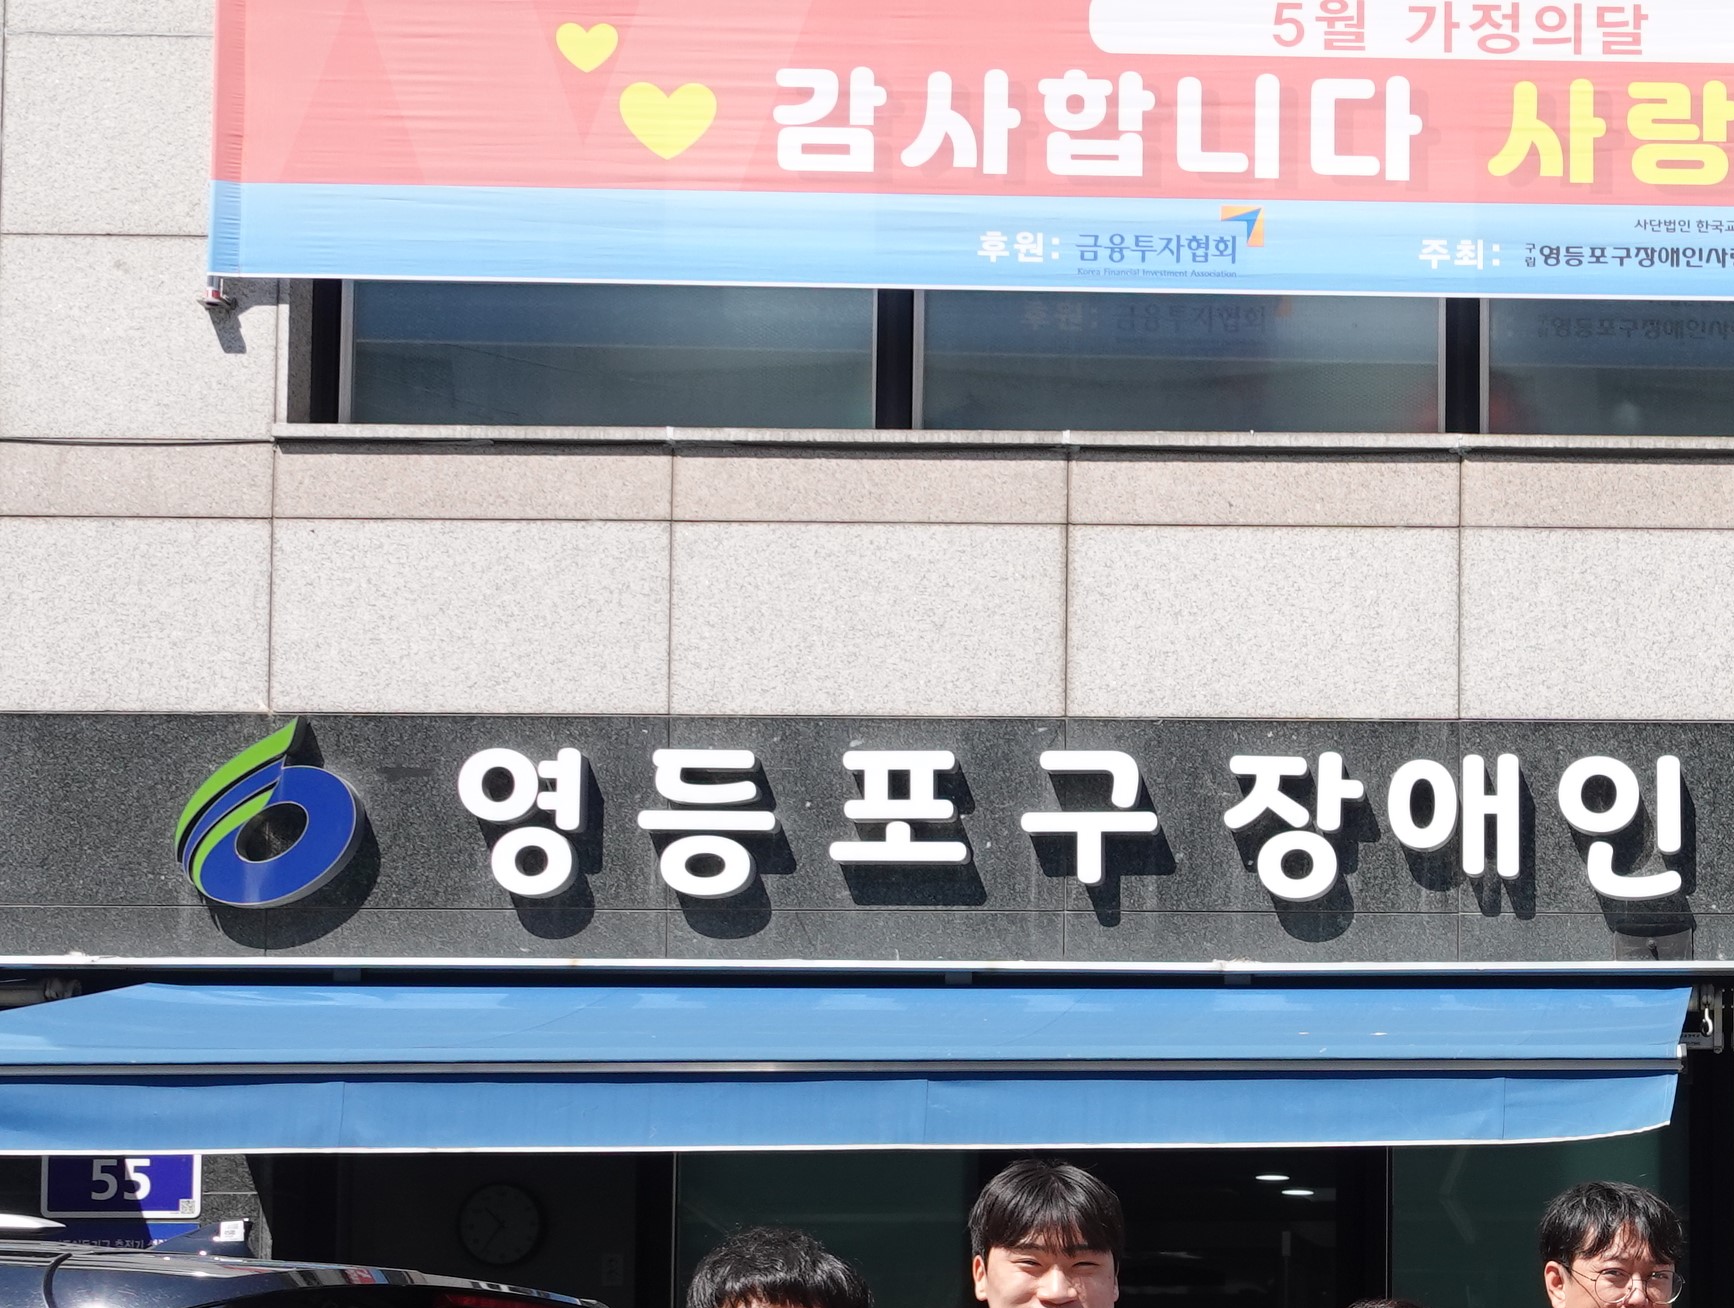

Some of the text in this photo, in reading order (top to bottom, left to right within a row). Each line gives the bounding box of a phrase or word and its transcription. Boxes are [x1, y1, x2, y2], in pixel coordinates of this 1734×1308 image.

[1273, 0, 1649, 56] 5월 가정의달
[773, 66, 1424, 181] 감사합니다
[1634, 218, 1691, 233] 사단법인
[977, 231, 1238, 265] 후원: 금융투자협회
[1418, 239, 1501, 270] 주최:
[91, 1158, 151, 1201] 55
